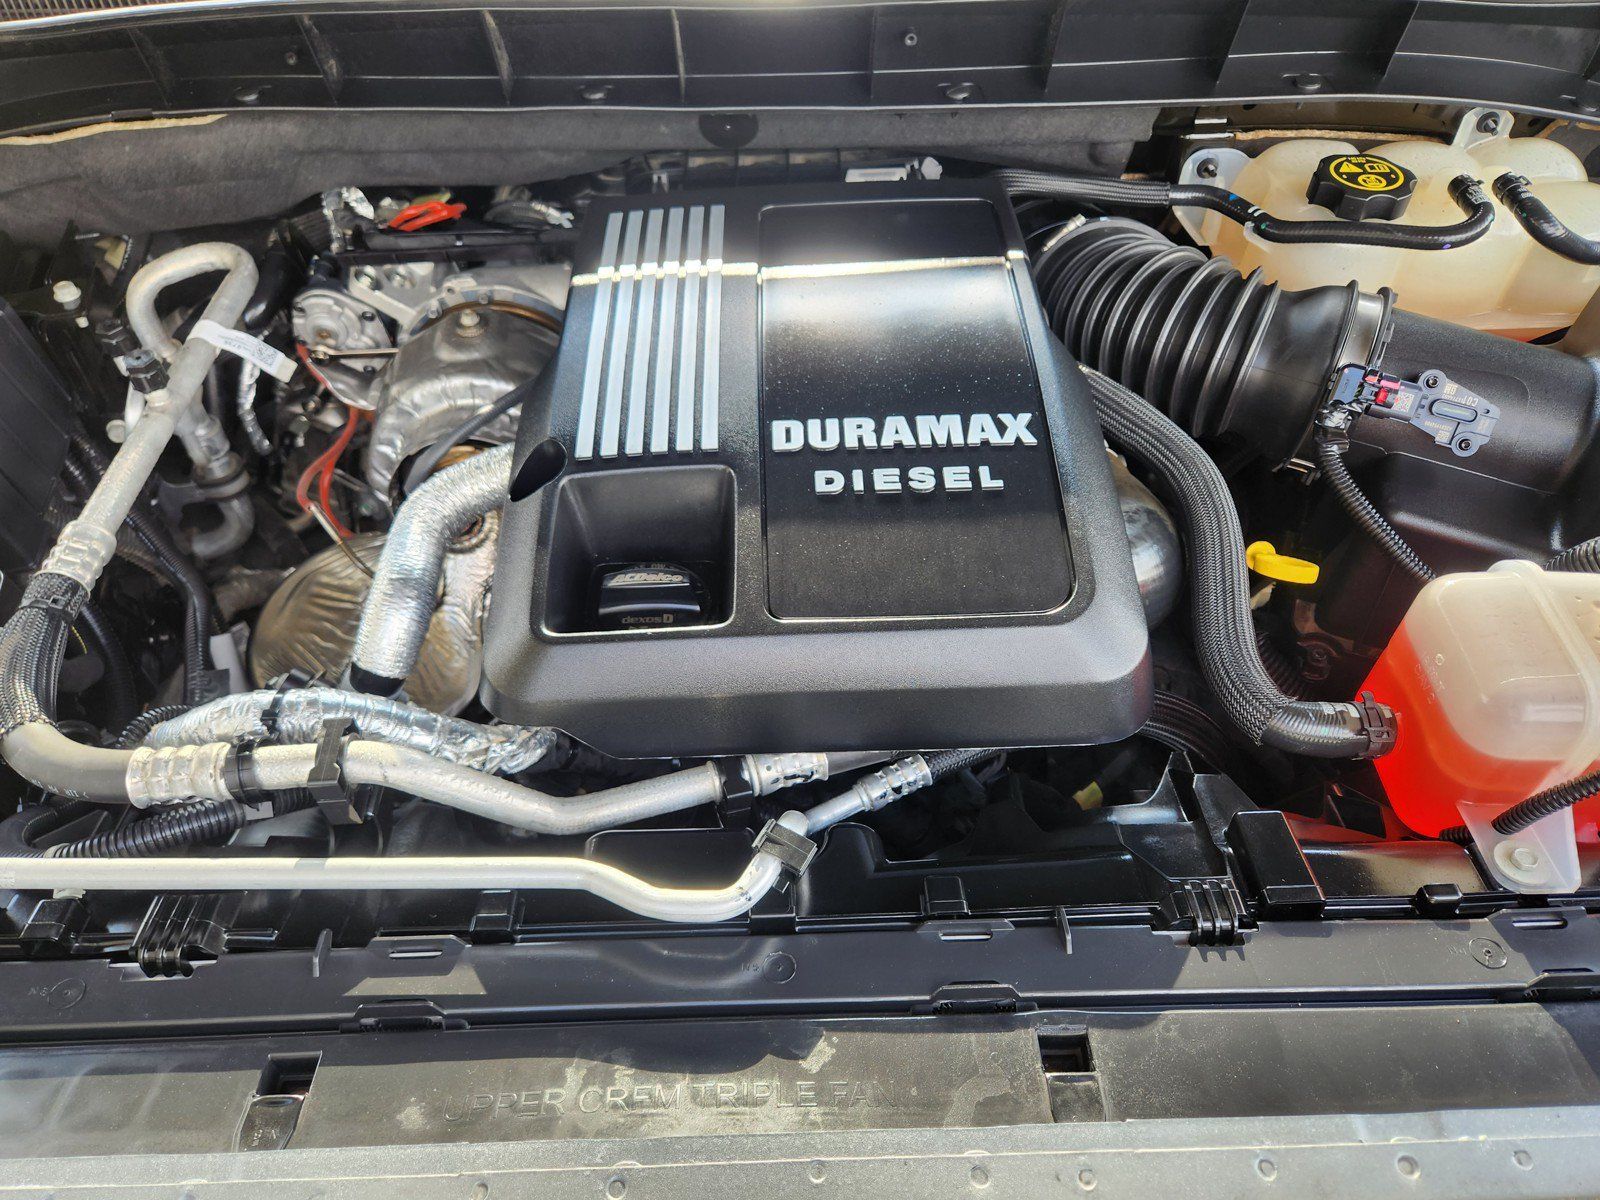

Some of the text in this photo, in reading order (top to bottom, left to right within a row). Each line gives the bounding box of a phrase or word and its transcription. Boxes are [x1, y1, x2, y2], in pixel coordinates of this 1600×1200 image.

[771, 413, 1038, 452] DURAMAX
[814, 465, 1005, 496] DIESEL
[443, 1087, 566, 1122] UPPER
[691, 1080, 818, 1109] TRIPLE
[829, 1080, 898, 1109] FAN
